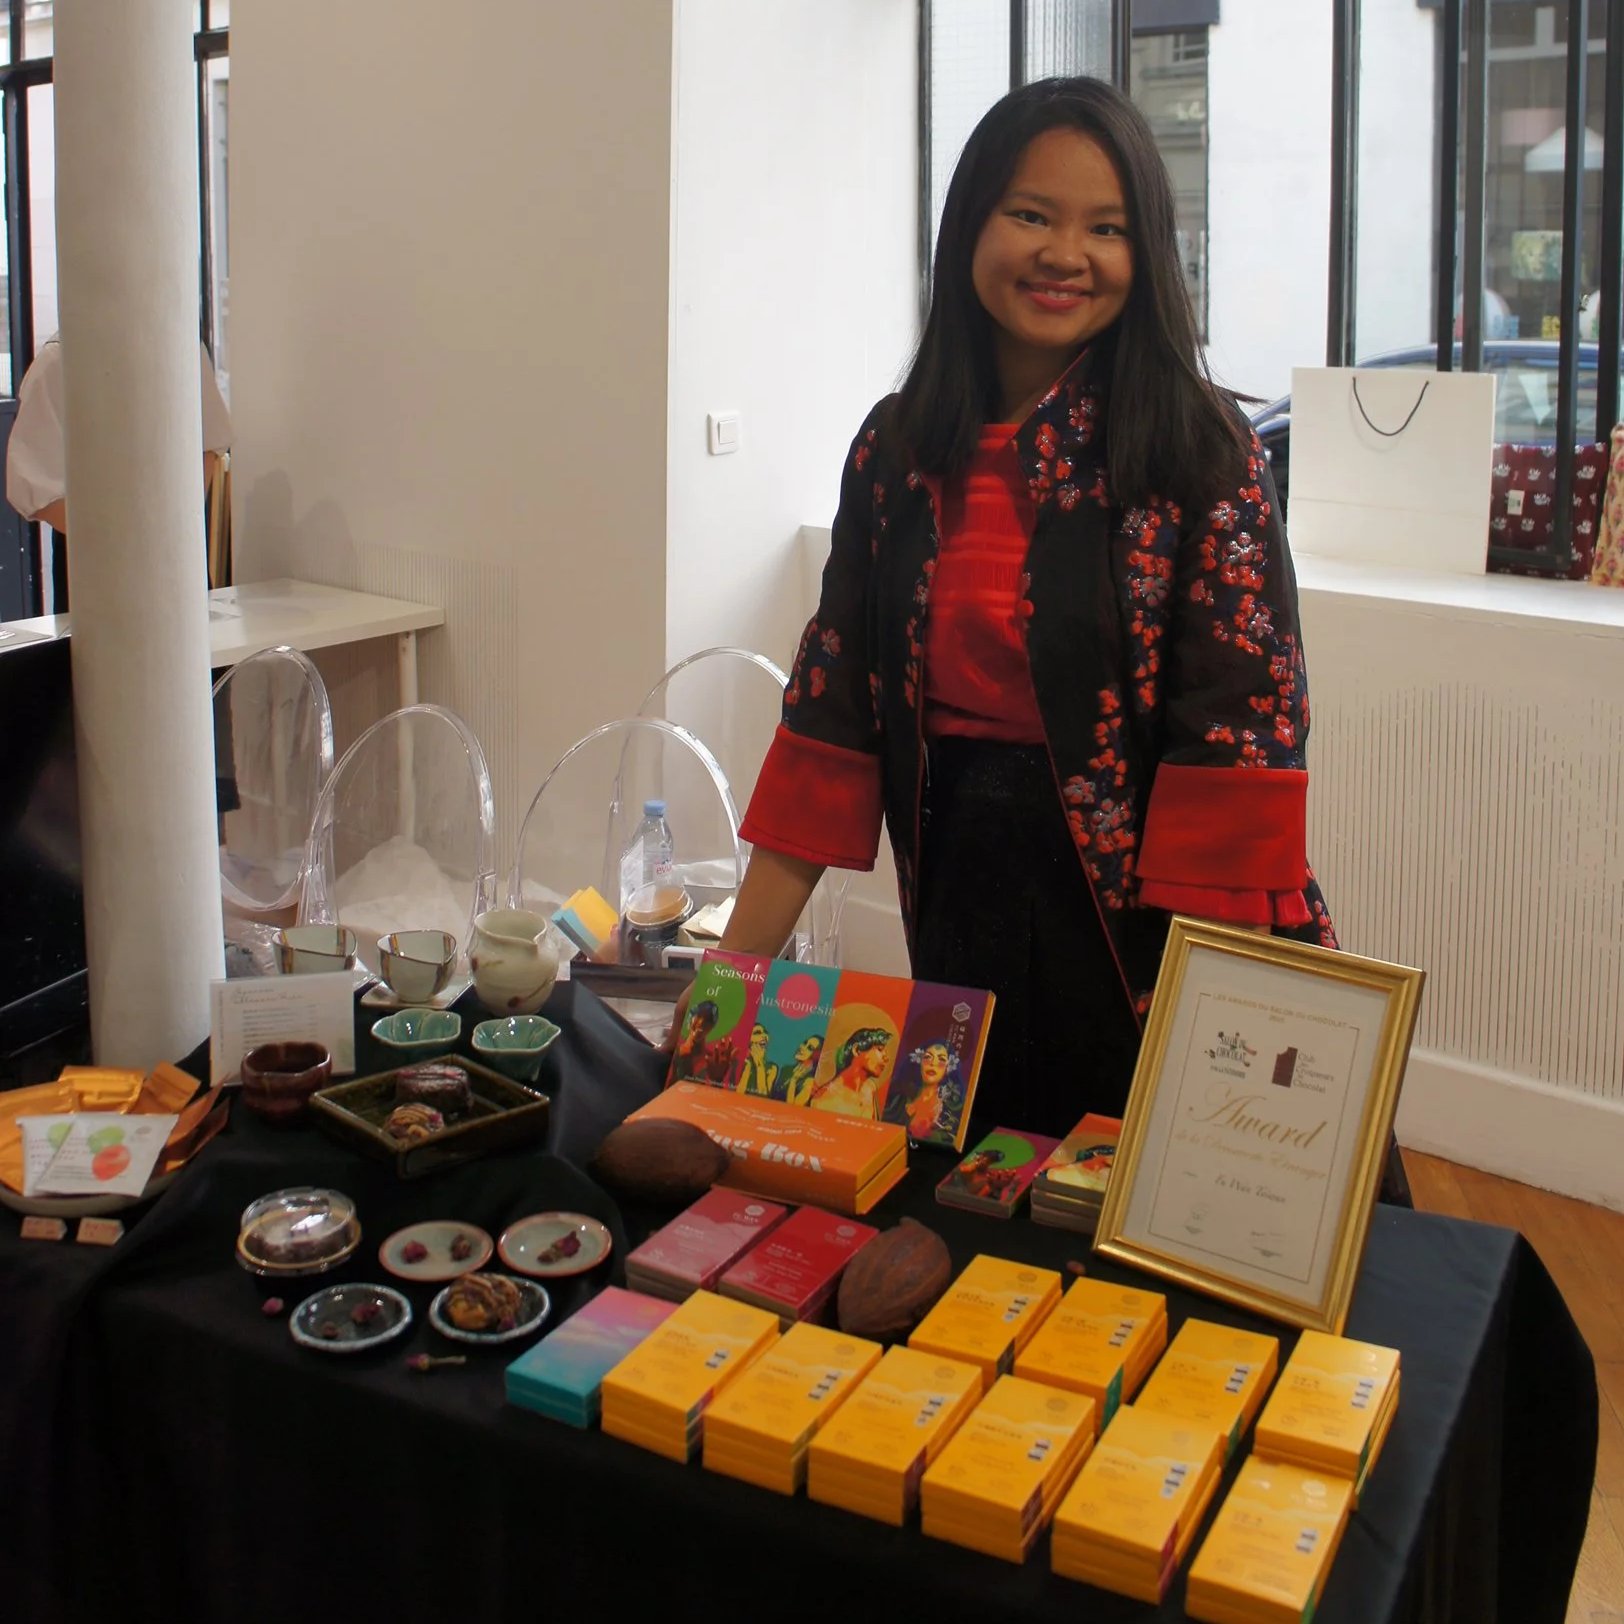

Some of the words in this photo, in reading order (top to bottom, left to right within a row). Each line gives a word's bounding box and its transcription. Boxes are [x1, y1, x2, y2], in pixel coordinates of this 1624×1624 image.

[712, 964, 766, 983] Seasons
[706, 986, 722, 997] of
[755, 993, 836, 1018] Austronesia
[1293, 1079, 1326, 1094] Chocolat
[1186, 1081, 1328, 1149] Award
[760, 1142, 825, 1173] Box
